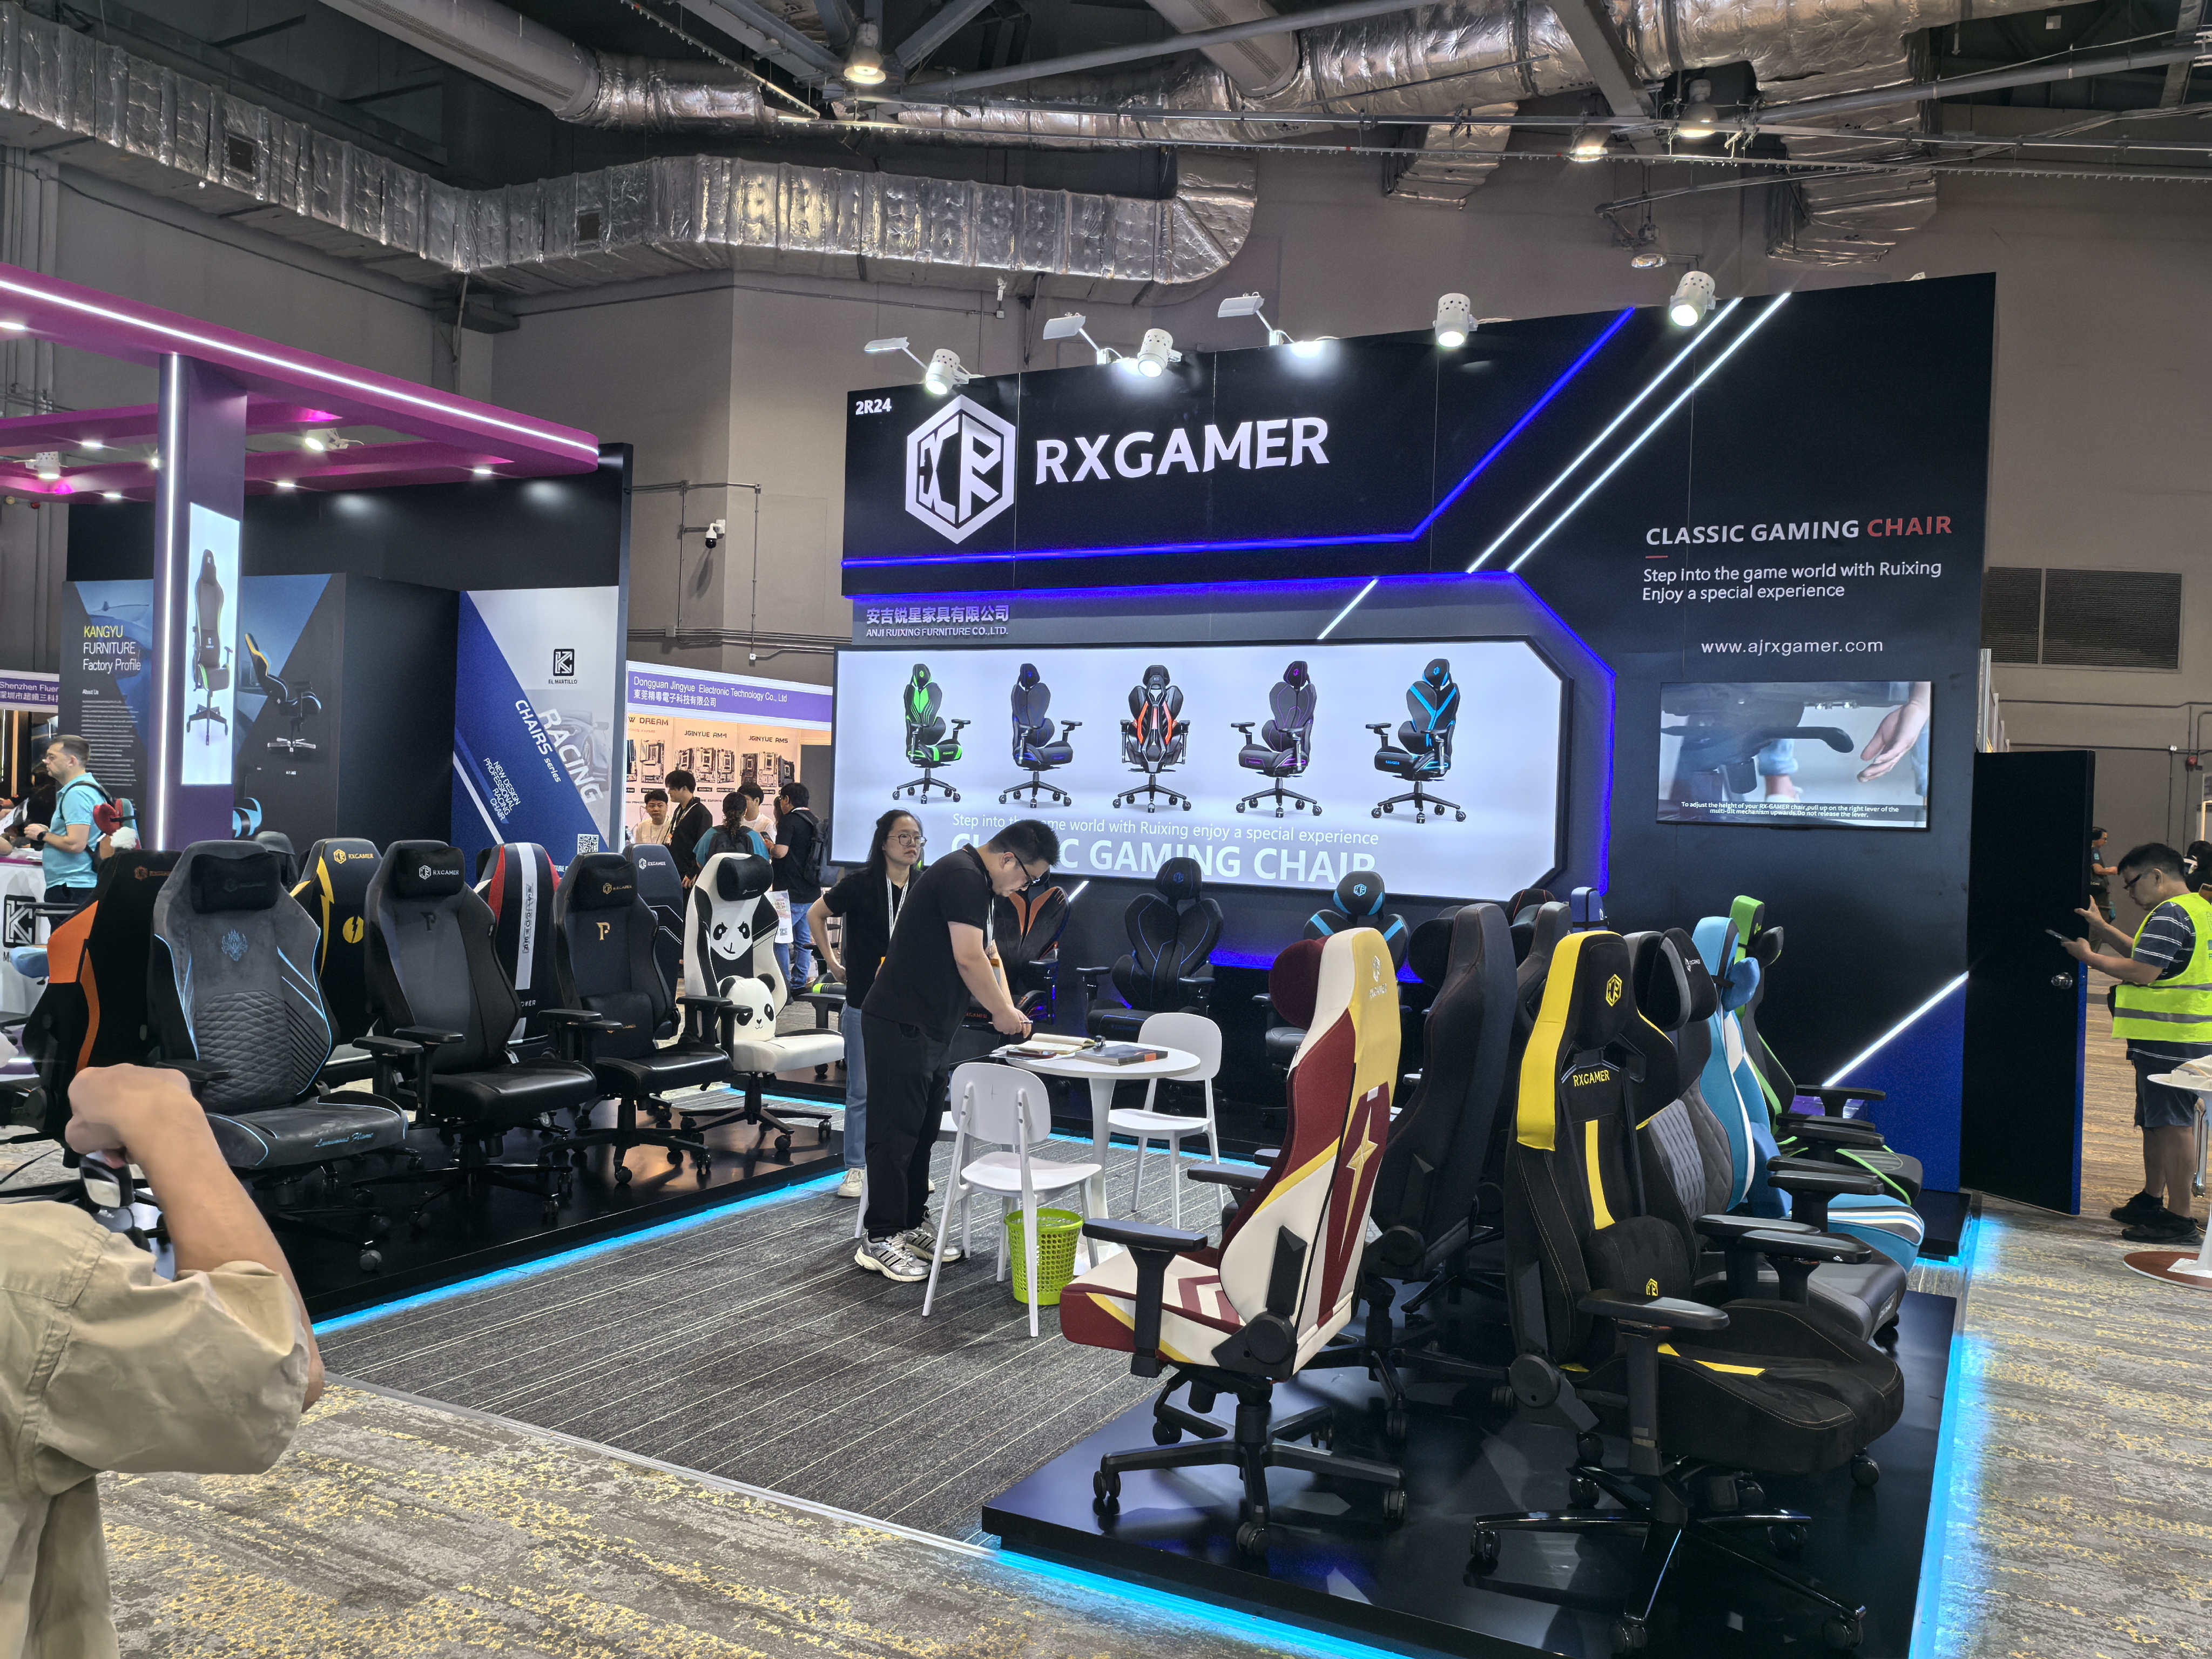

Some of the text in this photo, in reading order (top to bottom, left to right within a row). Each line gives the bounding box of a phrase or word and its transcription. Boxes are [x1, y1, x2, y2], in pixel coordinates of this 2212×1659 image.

[855, 399, 892, 415] 2R24
[1035, 416, 1329, 485] RXGAMER
[1646, 516, 1952, 545] CLASSIC GAMING CHAIR
[1644, 561, 1942, 585] Step into the game world with Ruixing
[1643, 584, 1845, 604] Enjoy a special experience
[866, 605, 1009, 624] 安吉锐星家具有限公司
[84, 625, 123, 638] KANGYU
[866, 626, 1009, 637] ANJI RUIXING FURNITURE CO.,LTD.
[83, 642, 136, 655] FURNITURE
[1701, 639, 1883, 656] www.ajrxgamer.com
[83, 658, 141, 674] Factory Profile
[0, 681, 37, 691] Shenzhen
[633, 676, 787, 702] Dongguan Jingyue Electronic Technology Co., Ltd
[639, 717, 669, 726] DREAM
[515, 699, 562, 783] CHAIRS series
[537, 708, 604, 804] RACING
[483, 757, 515, 811] PROFESSIONAL
[493, 760, 521, 805] NEW DESIGN
[490, 798, 506, 821] CHAIR
[492, 788, 510, 815] RACING
[953, 813, 1379, 846] Step into th me world with Ruixing enjoy a special experience
[1573, 1069, 1610, 1087] RXGAMER
